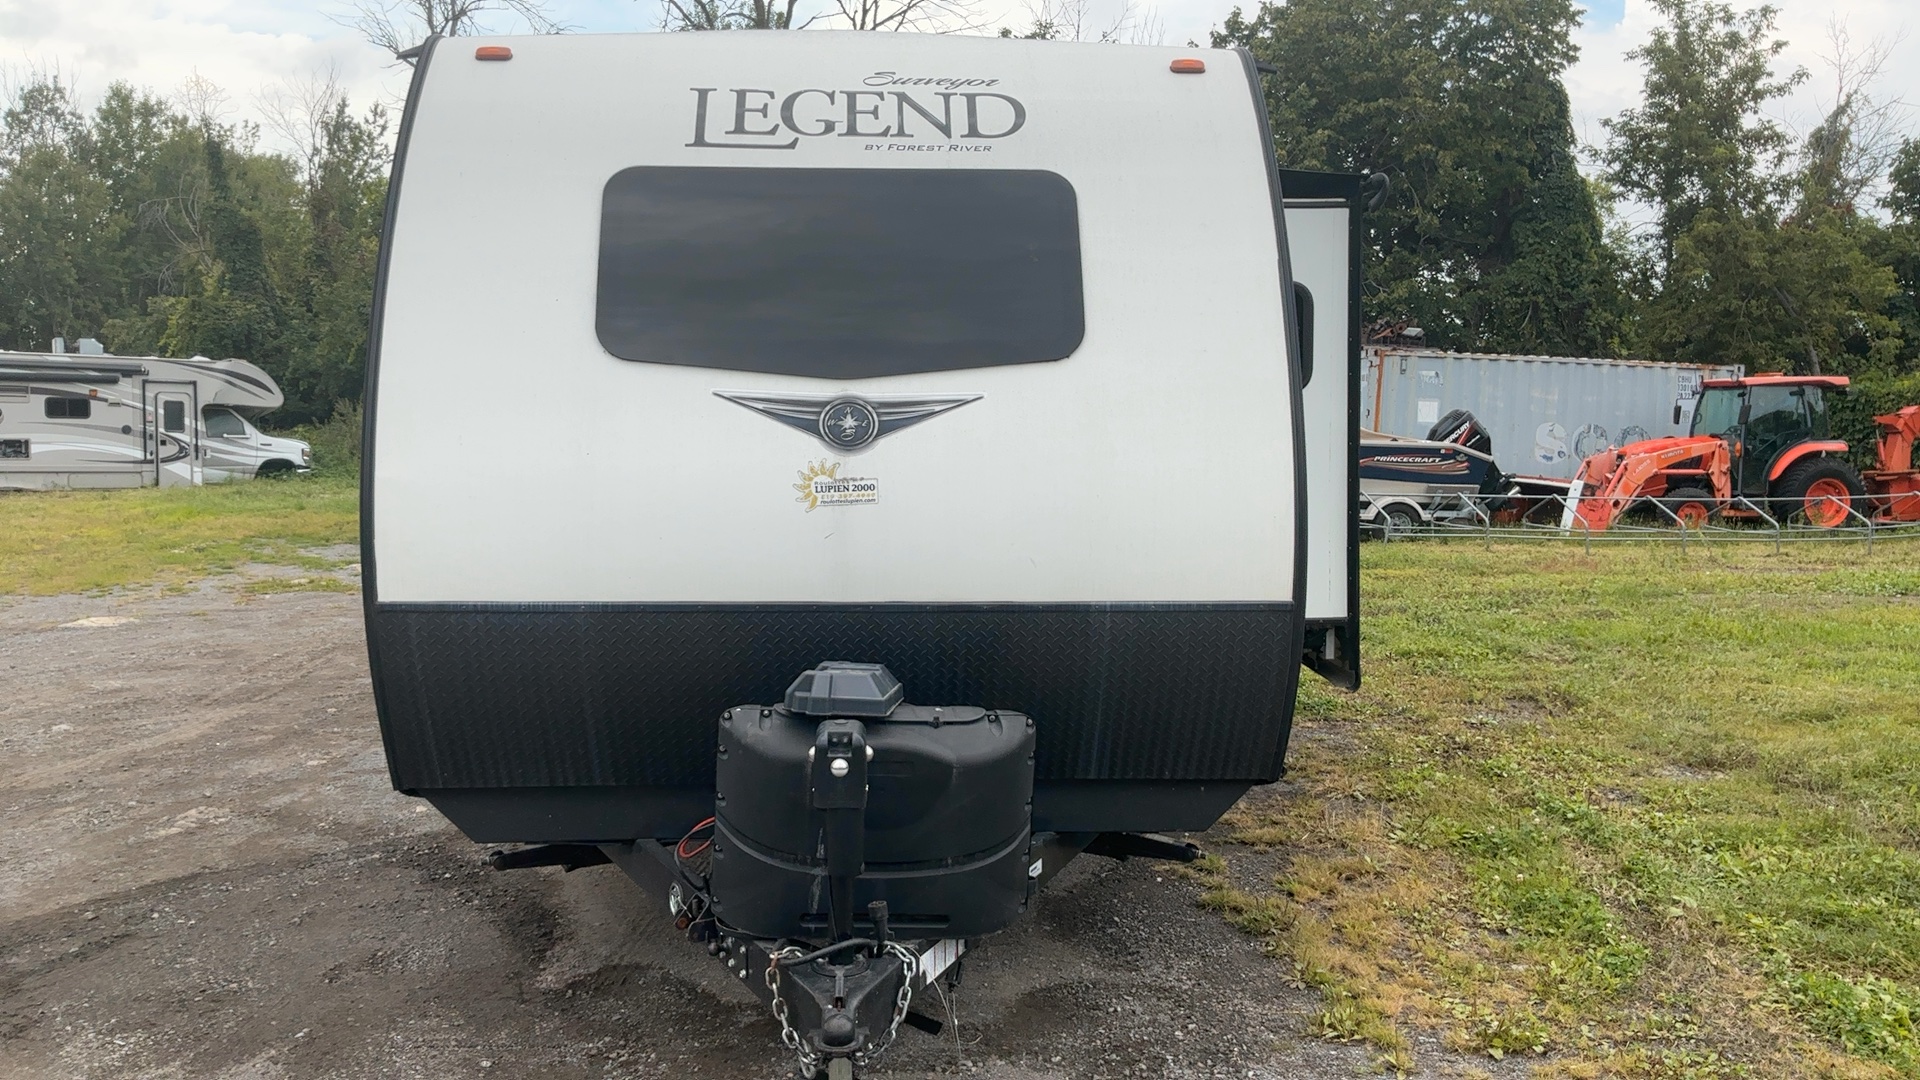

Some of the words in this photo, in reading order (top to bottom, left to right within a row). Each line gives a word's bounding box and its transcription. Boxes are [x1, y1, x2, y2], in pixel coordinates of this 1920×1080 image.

[862, 71, 1001, 90] Surveyor
[684, 87, 1027, 150] LEGEND
[887, 143, 944, 152] FOREST
[948, 144, 992, 152] RIVER
[1373, 455, 1442, 463] PRINCECRAFT
[815, 485, 850, 493] LUPIEN
[851, 483, 876, 492] 2000
